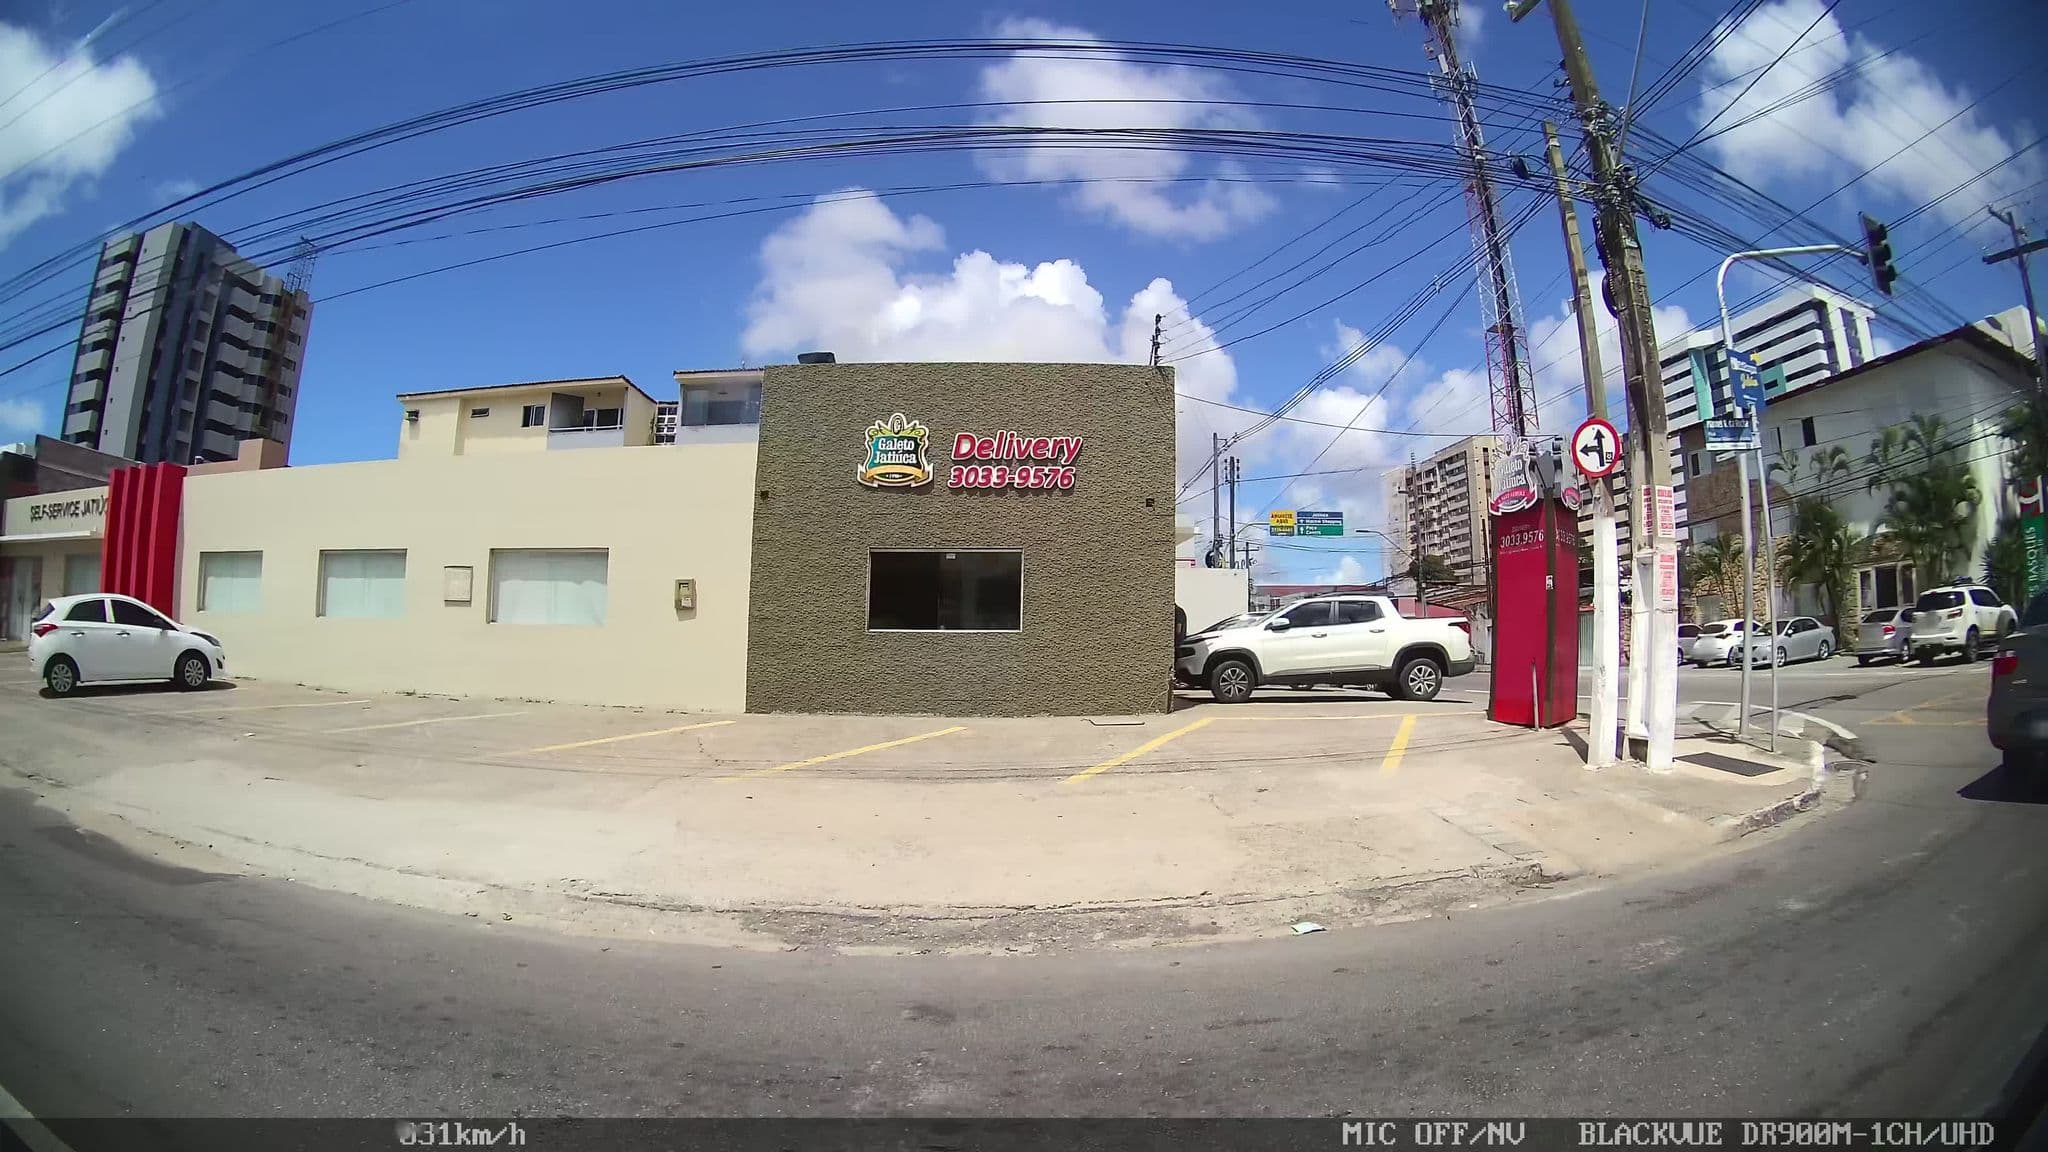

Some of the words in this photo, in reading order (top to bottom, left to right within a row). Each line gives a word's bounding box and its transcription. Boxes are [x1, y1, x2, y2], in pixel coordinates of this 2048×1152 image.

[878, 438, 915, 451] Galeto
[952, 430, 1082, 465] Delivery
[874, 449, 917, 464] Jatiúca
[948, 466, 1076, 489] 3033-9576
[31, 500, 80, 522] SELF-SERVICE
[1500, 529, 1544, 548] 3033.9576
